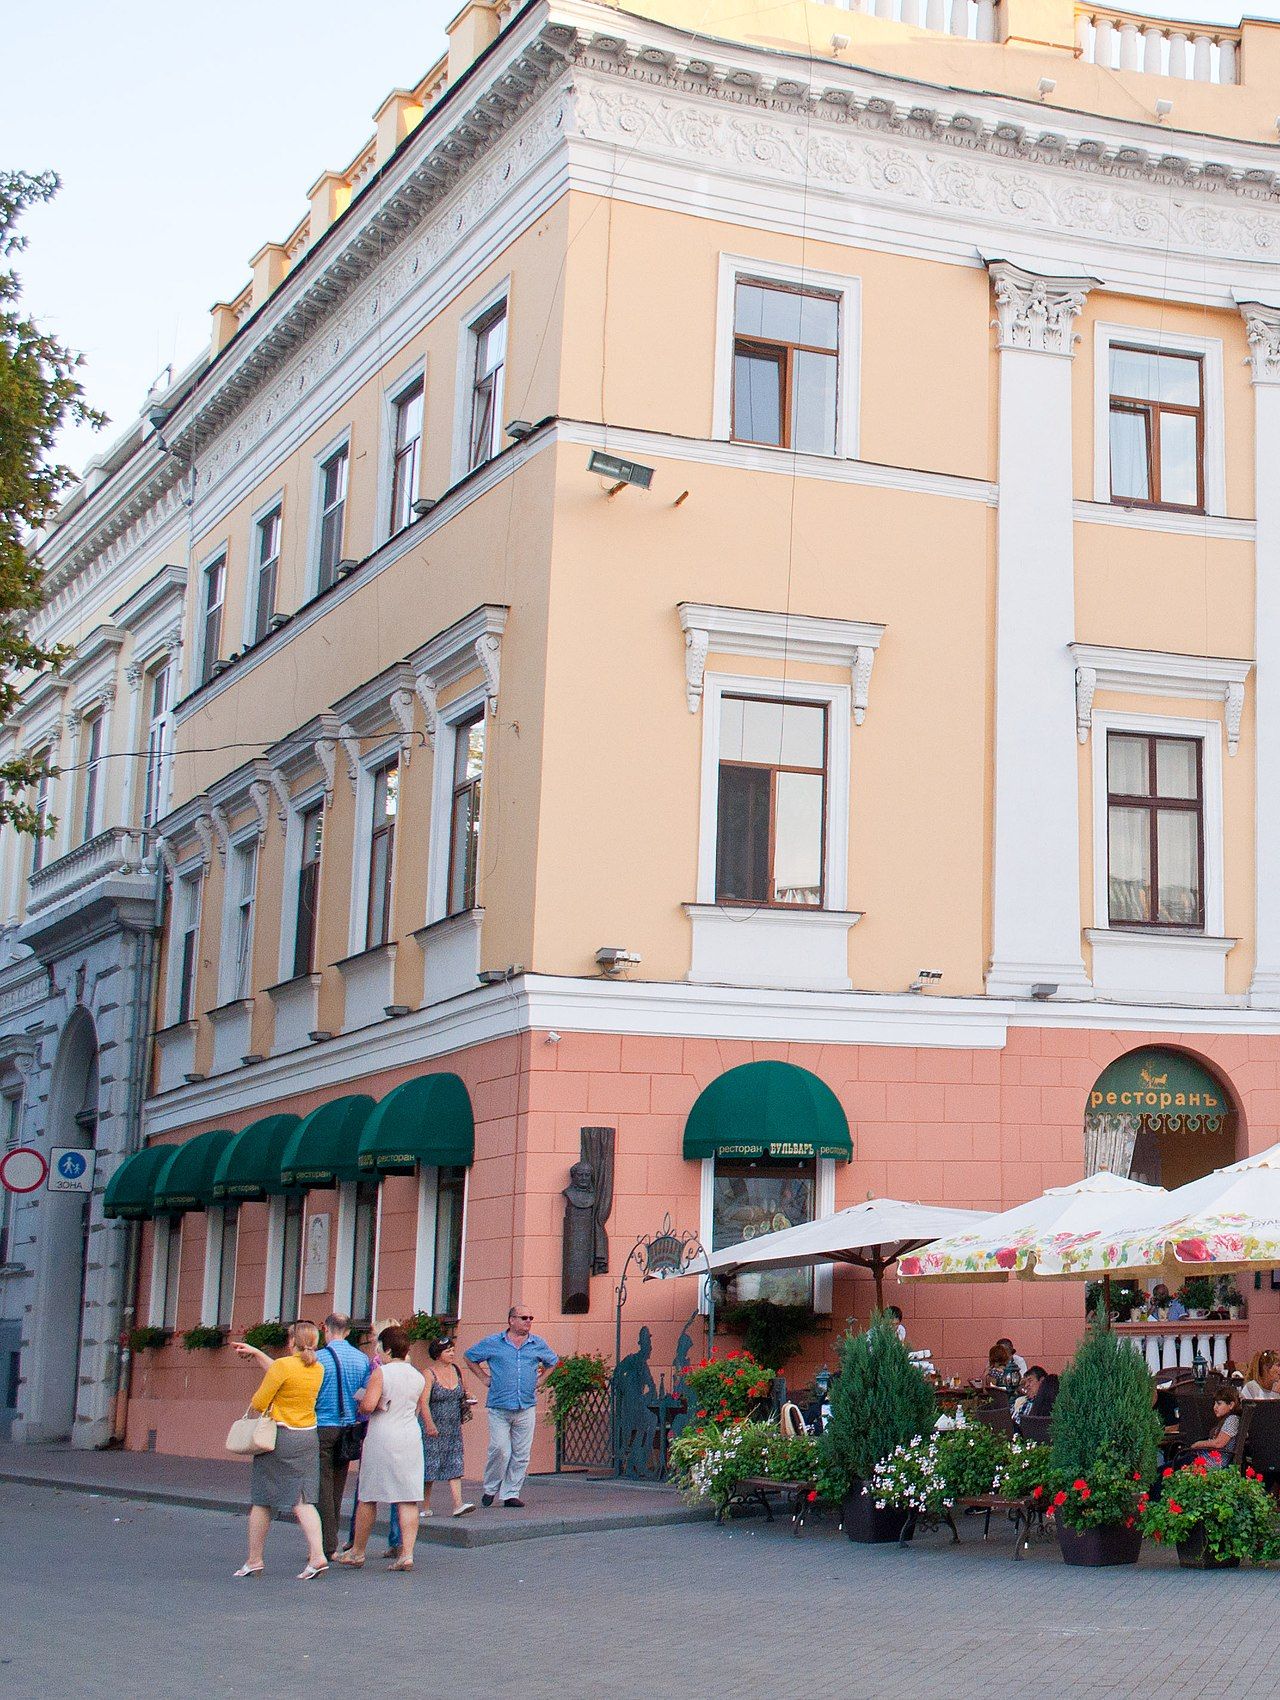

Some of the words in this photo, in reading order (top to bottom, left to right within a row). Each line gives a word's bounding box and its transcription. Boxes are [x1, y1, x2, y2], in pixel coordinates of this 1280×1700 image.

[1090, 1090, 1218, 1109] ресторанъ
[719, 1145, 763, 1155] ресторан
[57, 1181, 84, 1190] ЗОНА
